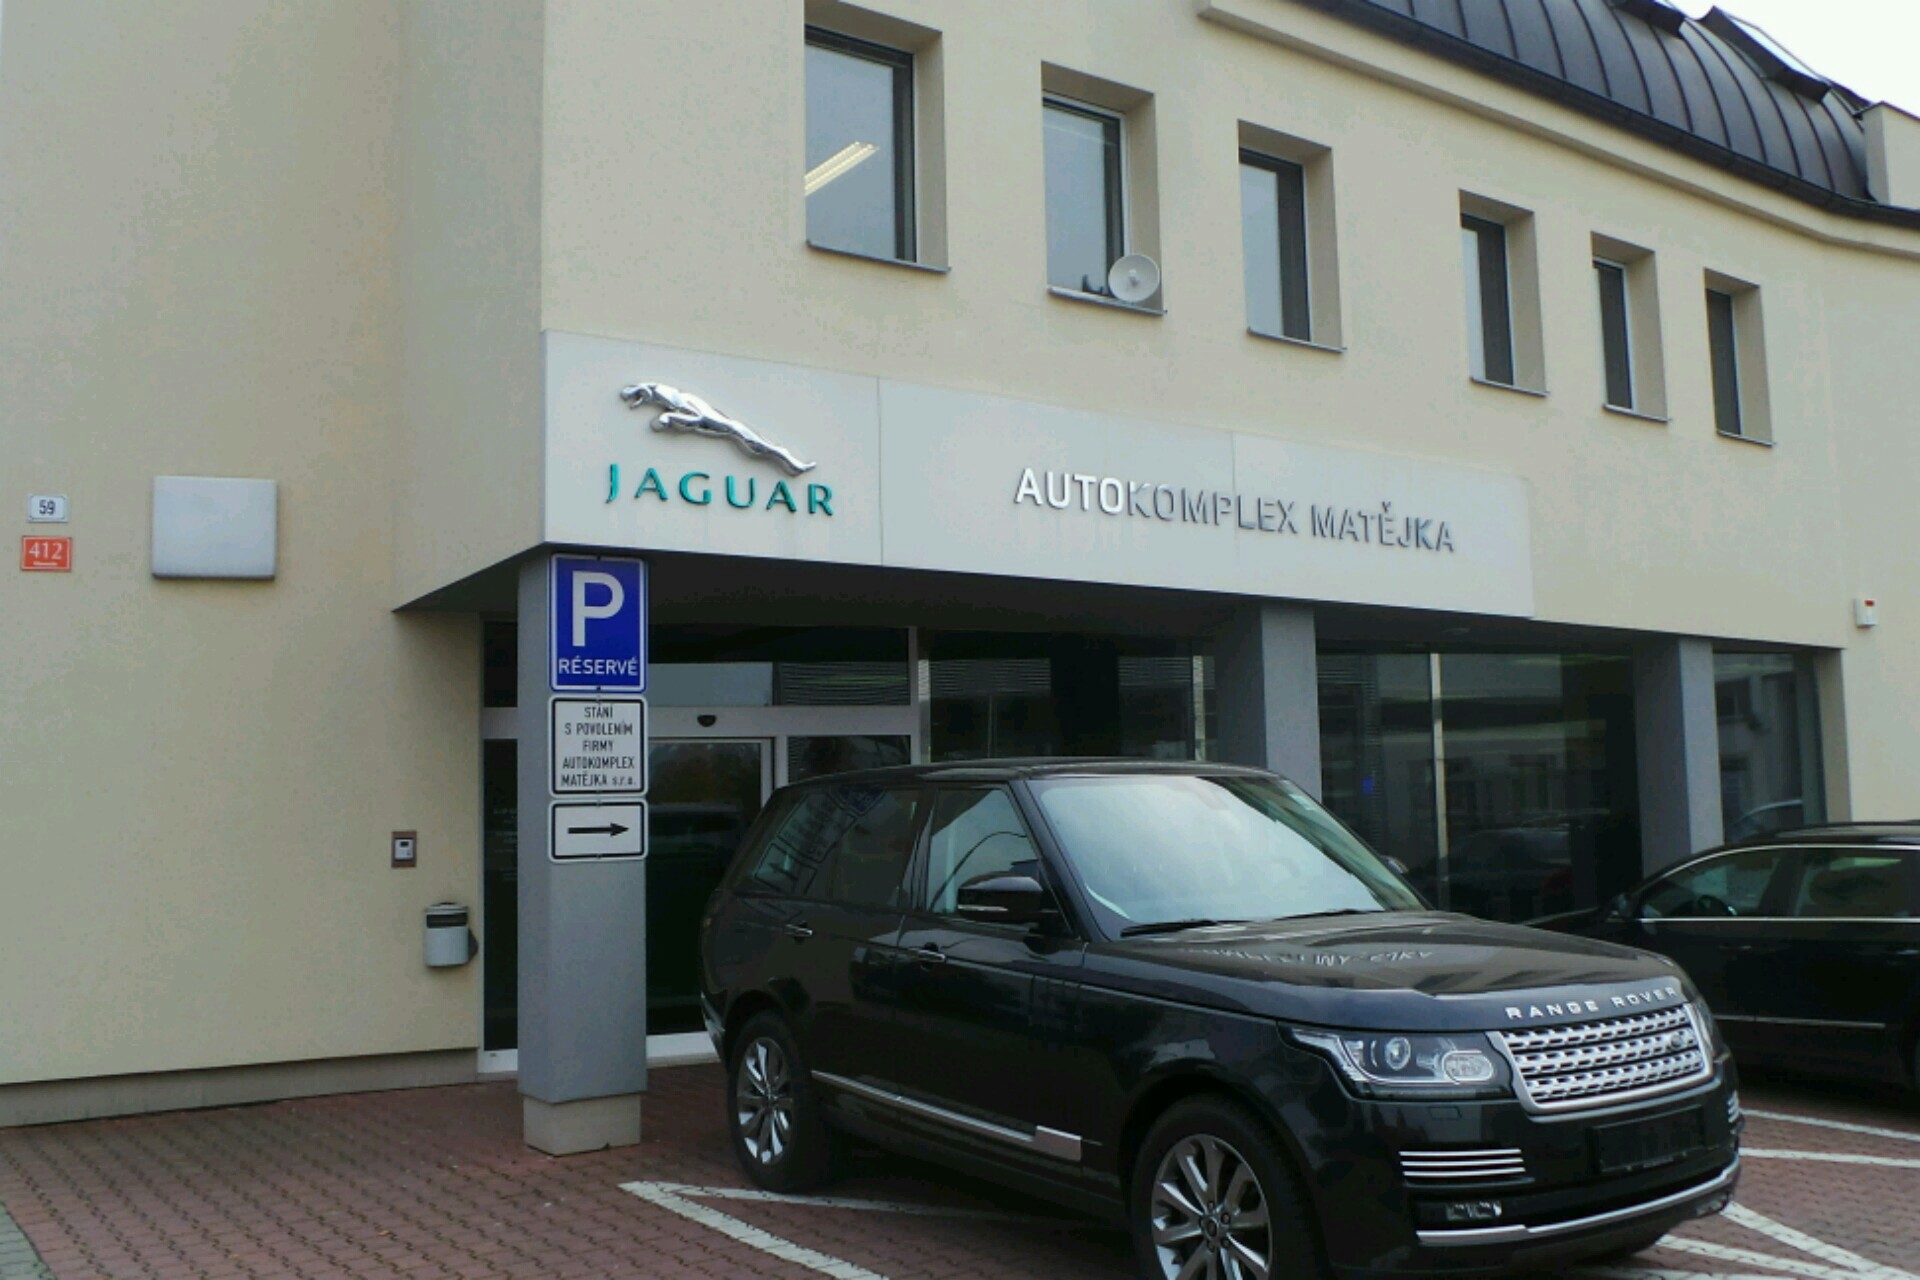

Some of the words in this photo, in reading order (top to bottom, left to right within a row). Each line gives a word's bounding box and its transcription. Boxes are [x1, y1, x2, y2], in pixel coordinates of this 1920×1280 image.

[606, 463, 834, 516] JAGUAR
[39, 499, 56, 515] 59
[1015, 467, 1298, 534] AUTOKOMPLEX
[1310, 501, 1454, 552] MATĚJKA
[28, 541, 63, 560] 412
[571, 570, 625, 647] P
[558, 655, 639, 676] RÉSERVÉ
[564, 722, 572, 735] S
[582, 740, 614, 752] FIRMY
[562, 756, 635, 769] AUTOKOMPLEX
[1505, 1000, 1600, 1020] RANGE
[1611, 986, 1678, 1008] ROVER
